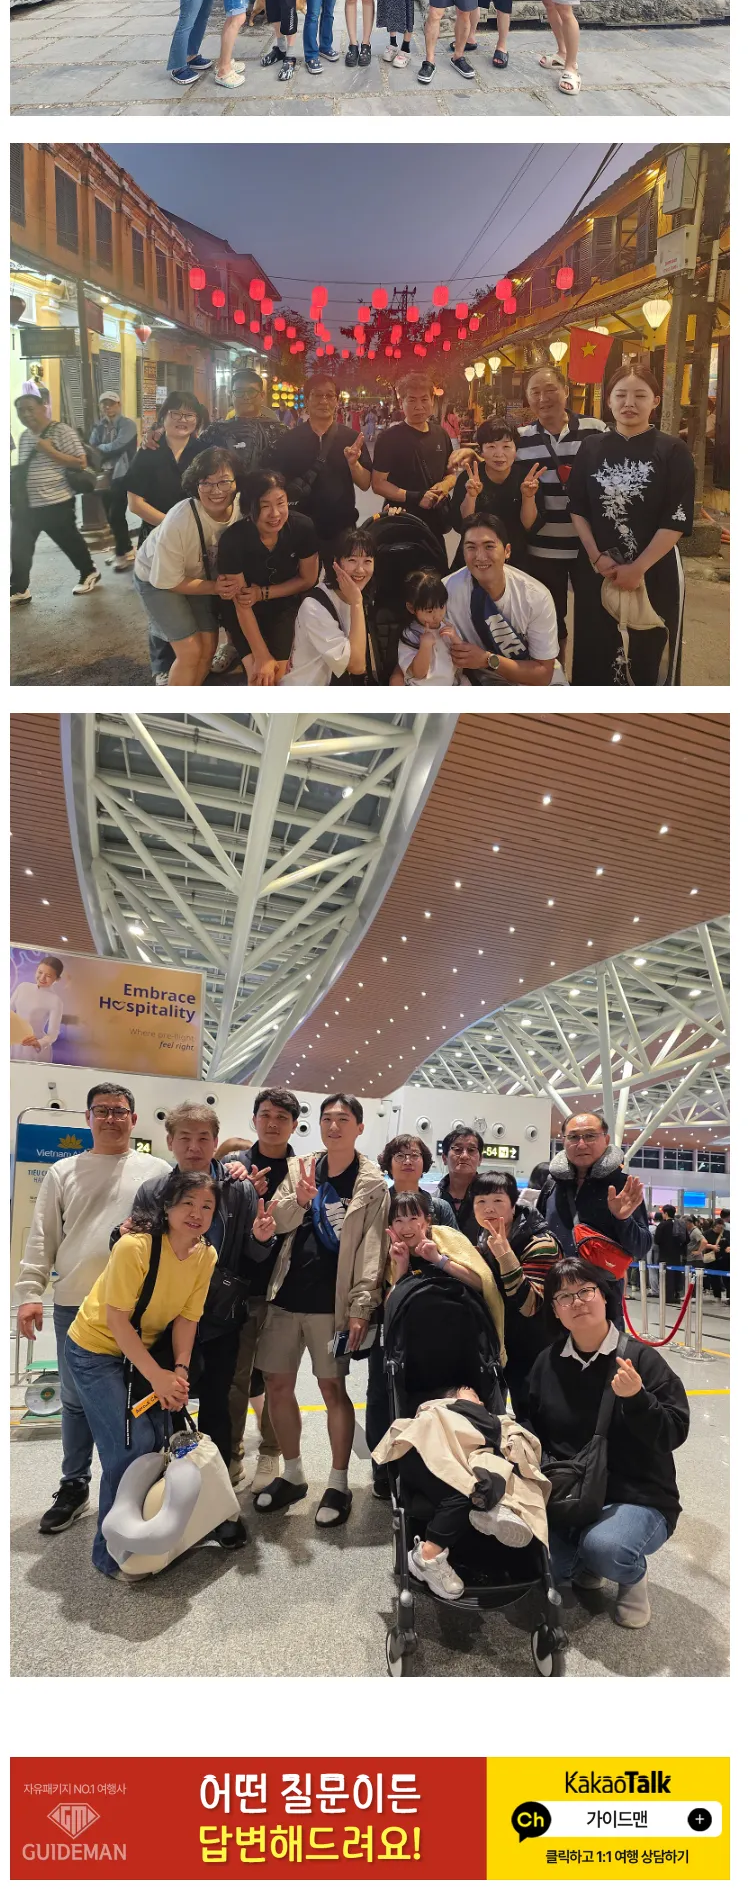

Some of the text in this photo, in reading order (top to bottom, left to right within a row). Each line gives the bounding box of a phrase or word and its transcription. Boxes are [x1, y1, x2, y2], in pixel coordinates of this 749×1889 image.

[484, 614, 527, 658] NIKE
[124, 983, 196, 1004] Embrace
[99, 996, 196, 1023] Hospitality
[129, 1028, 156, 1038] Where
[159, 1041, 195, 1052] feel right
[36, 1148, 72, 1158] Vietnam
[136, 1142, 150, 1153] 24
